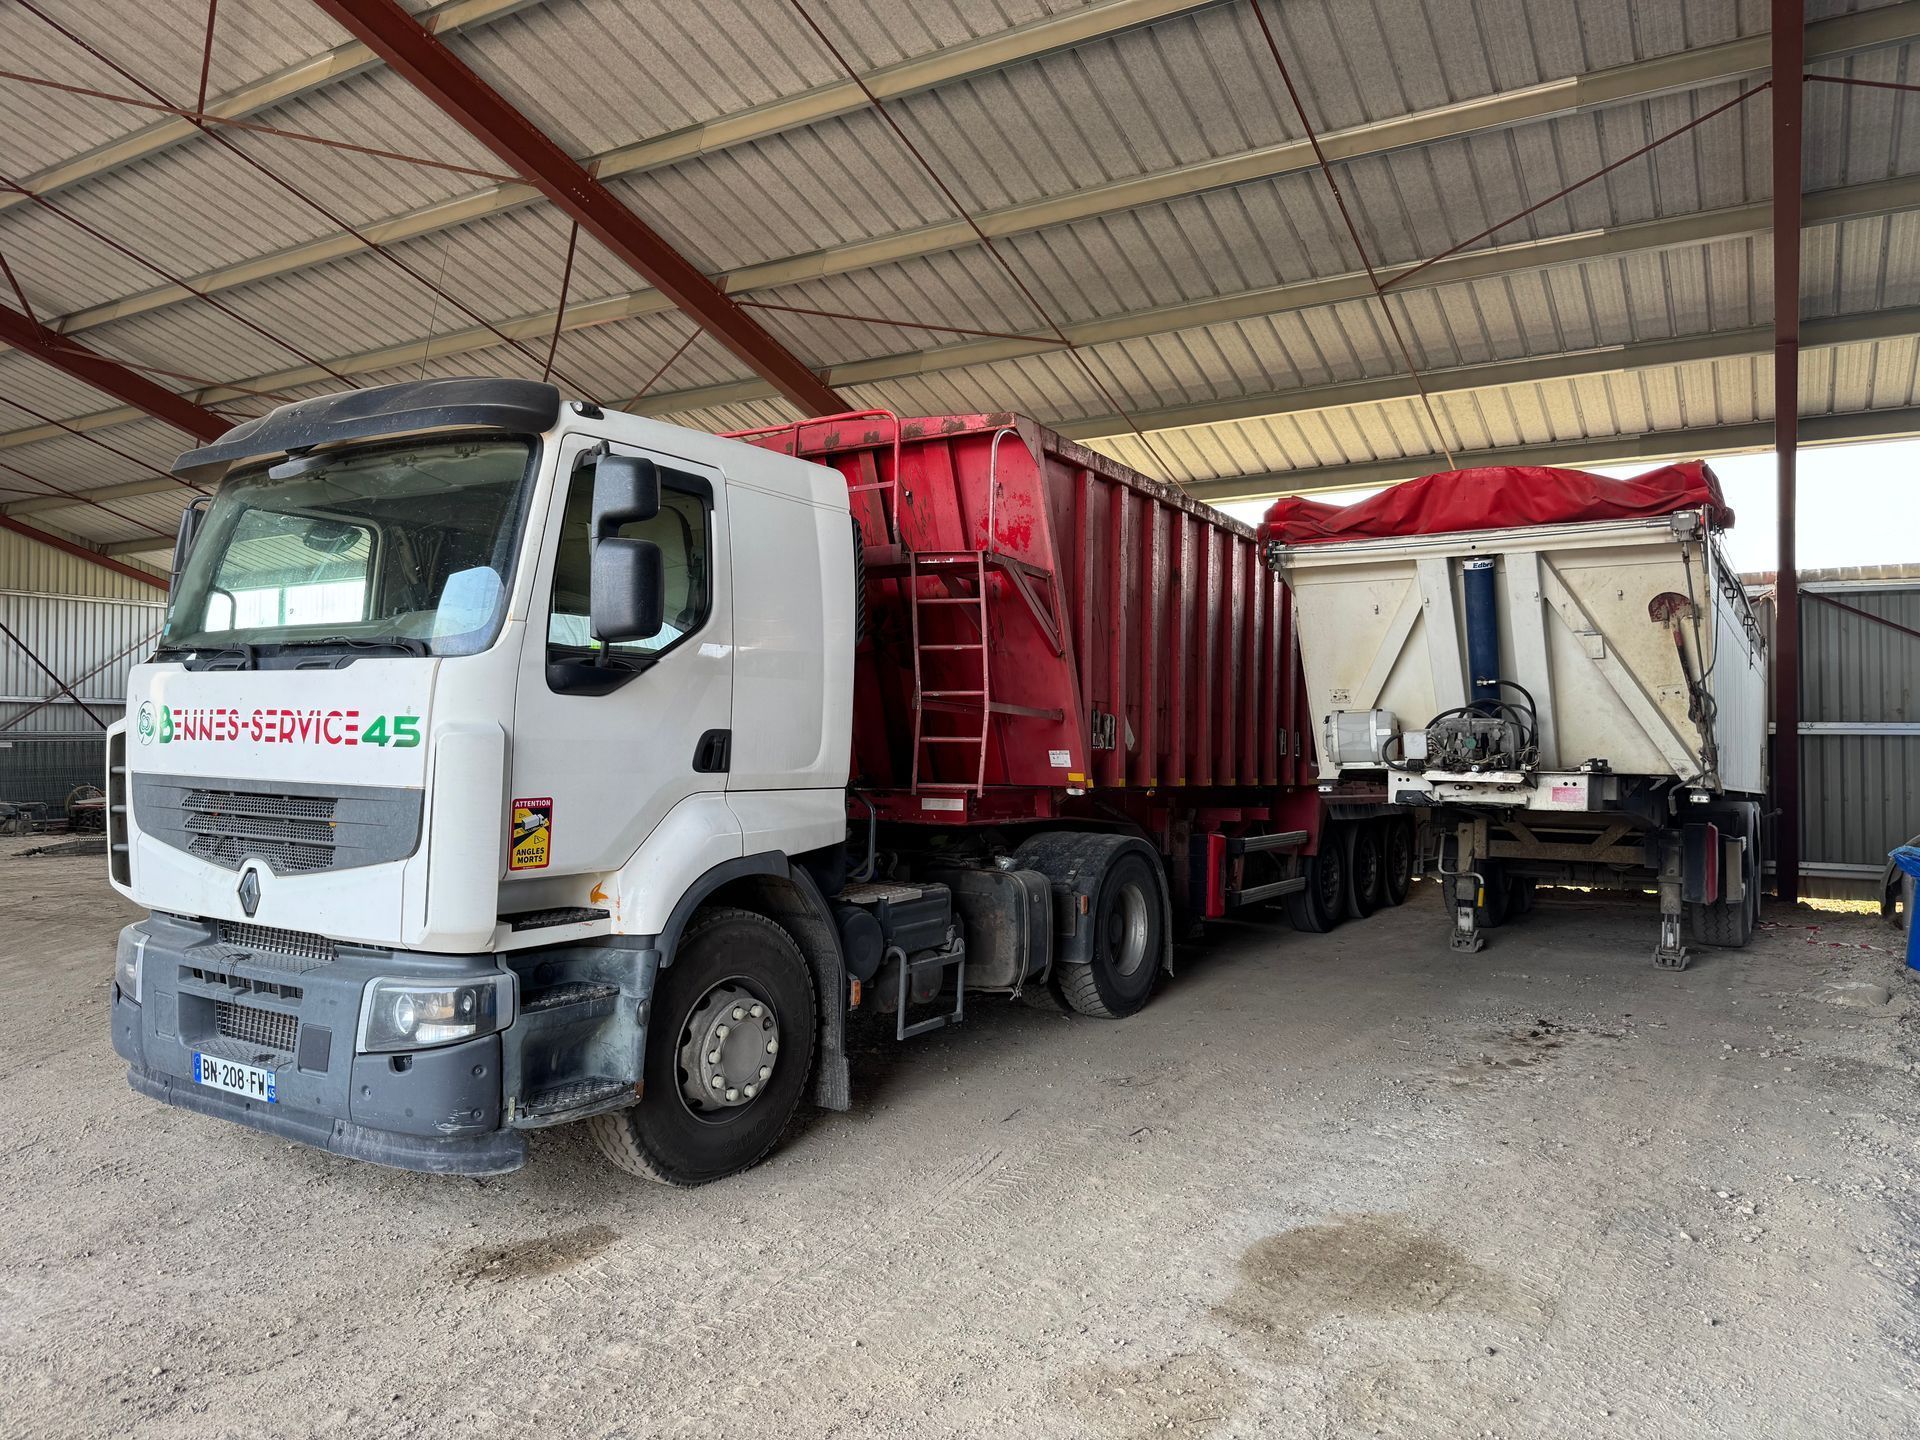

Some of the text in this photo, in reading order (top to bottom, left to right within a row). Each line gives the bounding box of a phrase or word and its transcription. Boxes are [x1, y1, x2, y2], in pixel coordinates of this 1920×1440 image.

[516, 847, 544, 856] ANGLES
[517, 855, 543, 864] MORTS
[202, 1058, 265, 1096] BN-208-FW
